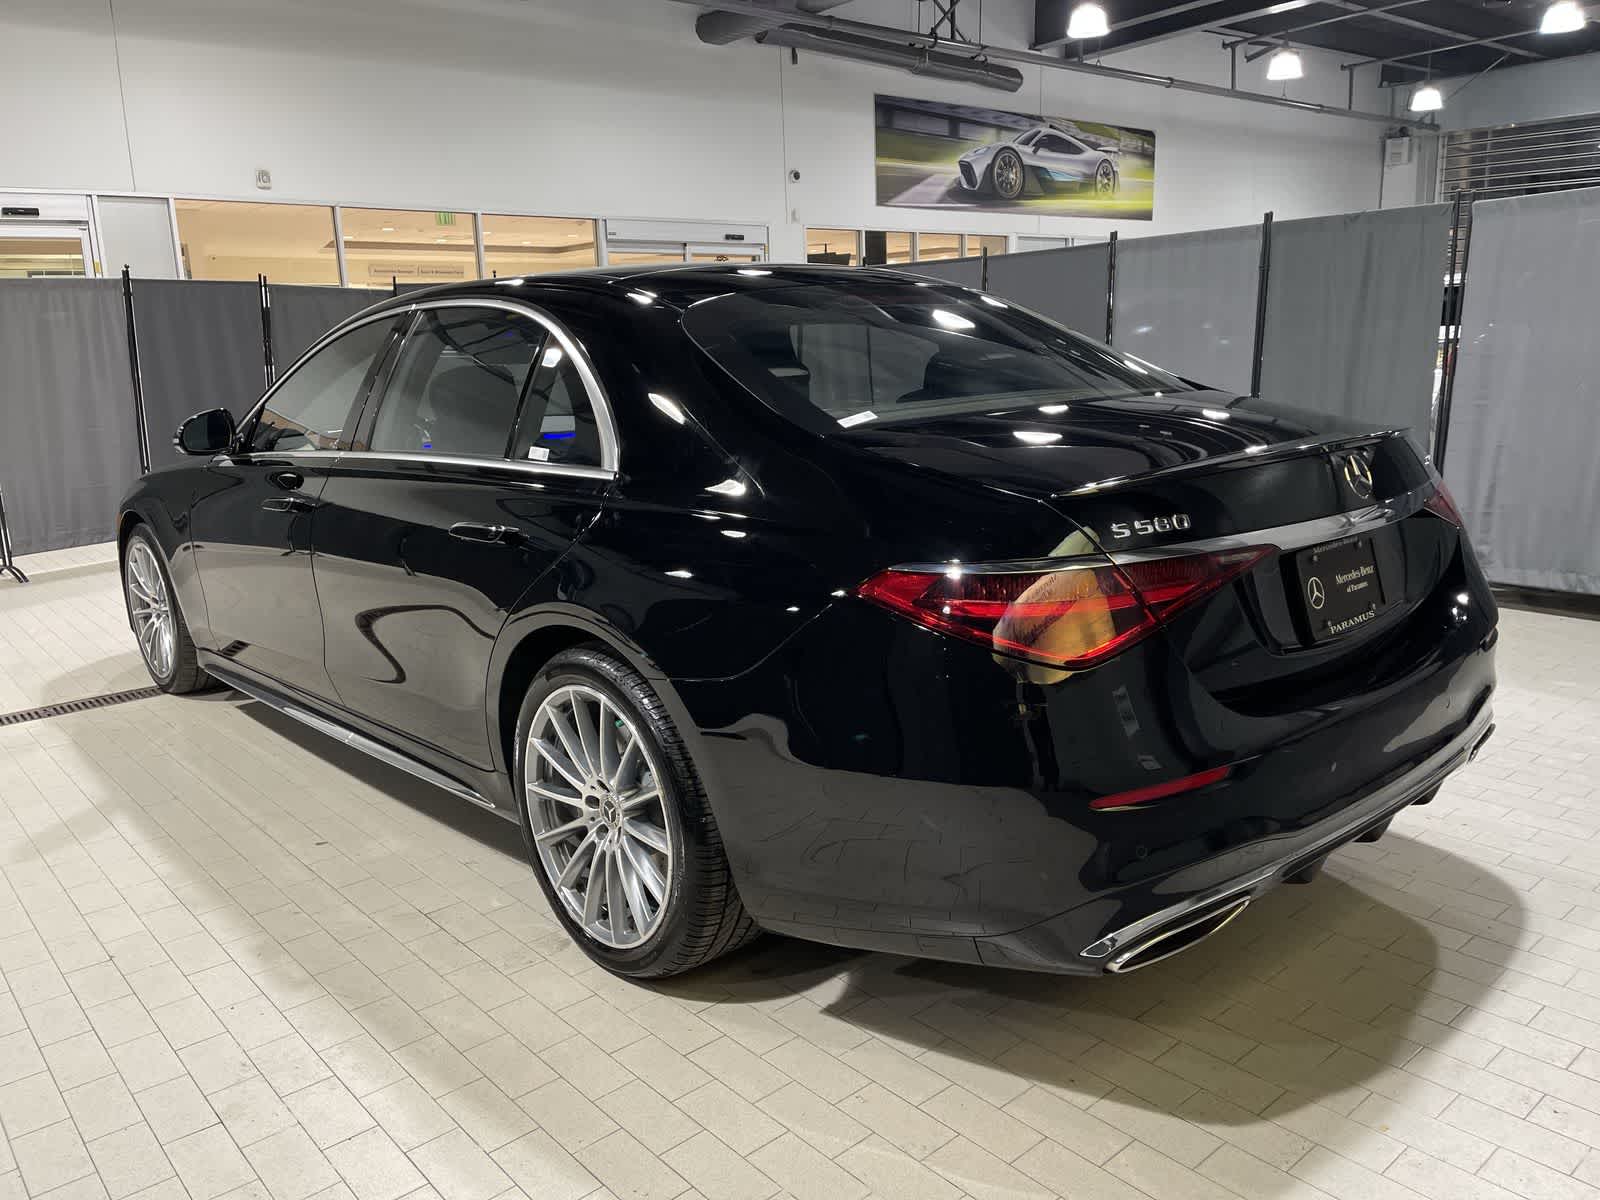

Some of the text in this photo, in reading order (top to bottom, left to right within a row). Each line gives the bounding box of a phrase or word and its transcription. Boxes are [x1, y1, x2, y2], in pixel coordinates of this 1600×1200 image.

[1111, 523, 1131, 539] S
[1336, 565, 1374, 584] Mercedes-Benz
[1330, 610, 1375, 634] PARAMUS
